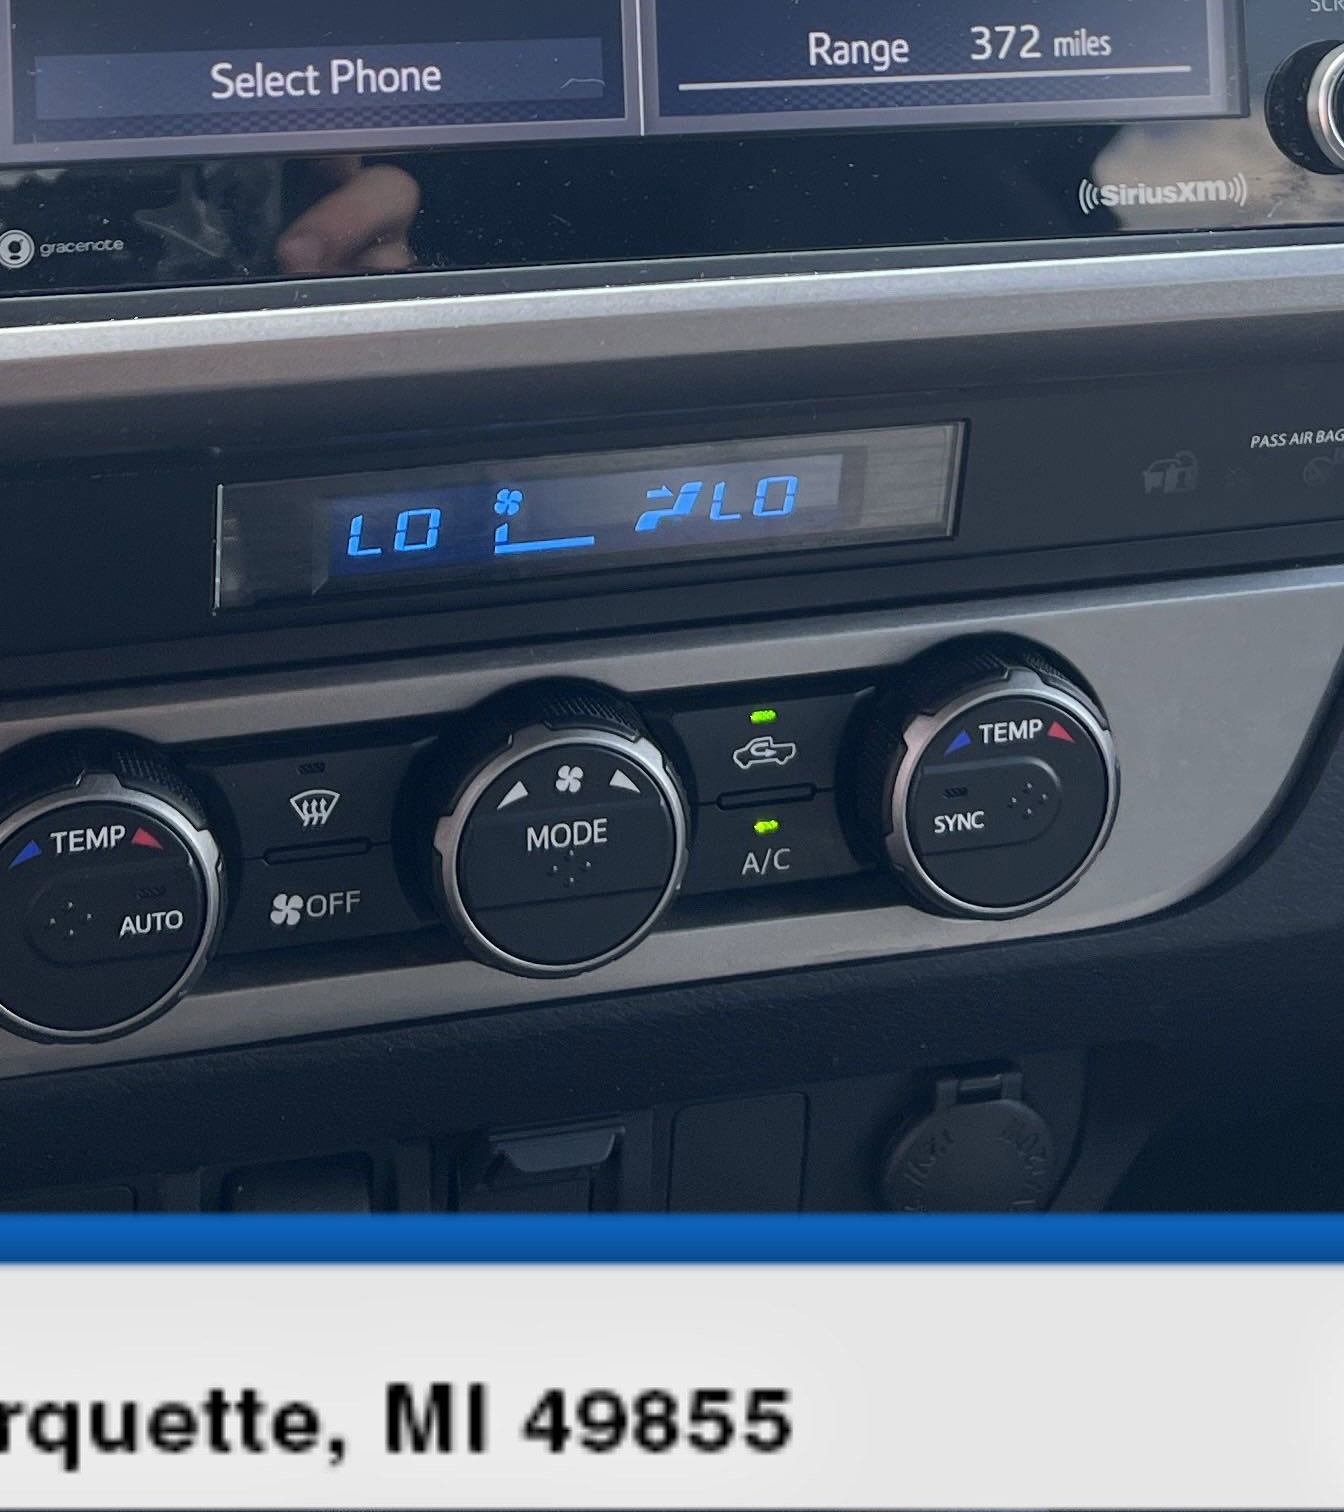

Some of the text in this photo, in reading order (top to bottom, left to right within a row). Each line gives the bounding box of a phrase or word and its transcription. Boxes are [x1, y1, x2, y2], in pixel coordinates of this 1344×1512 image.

[807, 25, 1113, 69] Range 372 miles
[211, 59, 442, 100] Select Phone
[39, 239, 125, 258] gracenote
[1250, 433, 1287, 449] PASS
[1289, 432, 1313, 446] AIR
[979, 717, 1044, 745] TEMP
[526, 819, 609, 853] MODE
[933, 809, 986, 835] SYNC
[51, 824, 125, 855] TEMP
[741, 847, 792, 877] A/C
[306, 890, 362, 920] OFF
[119, 909, 184, 937] AUTO
